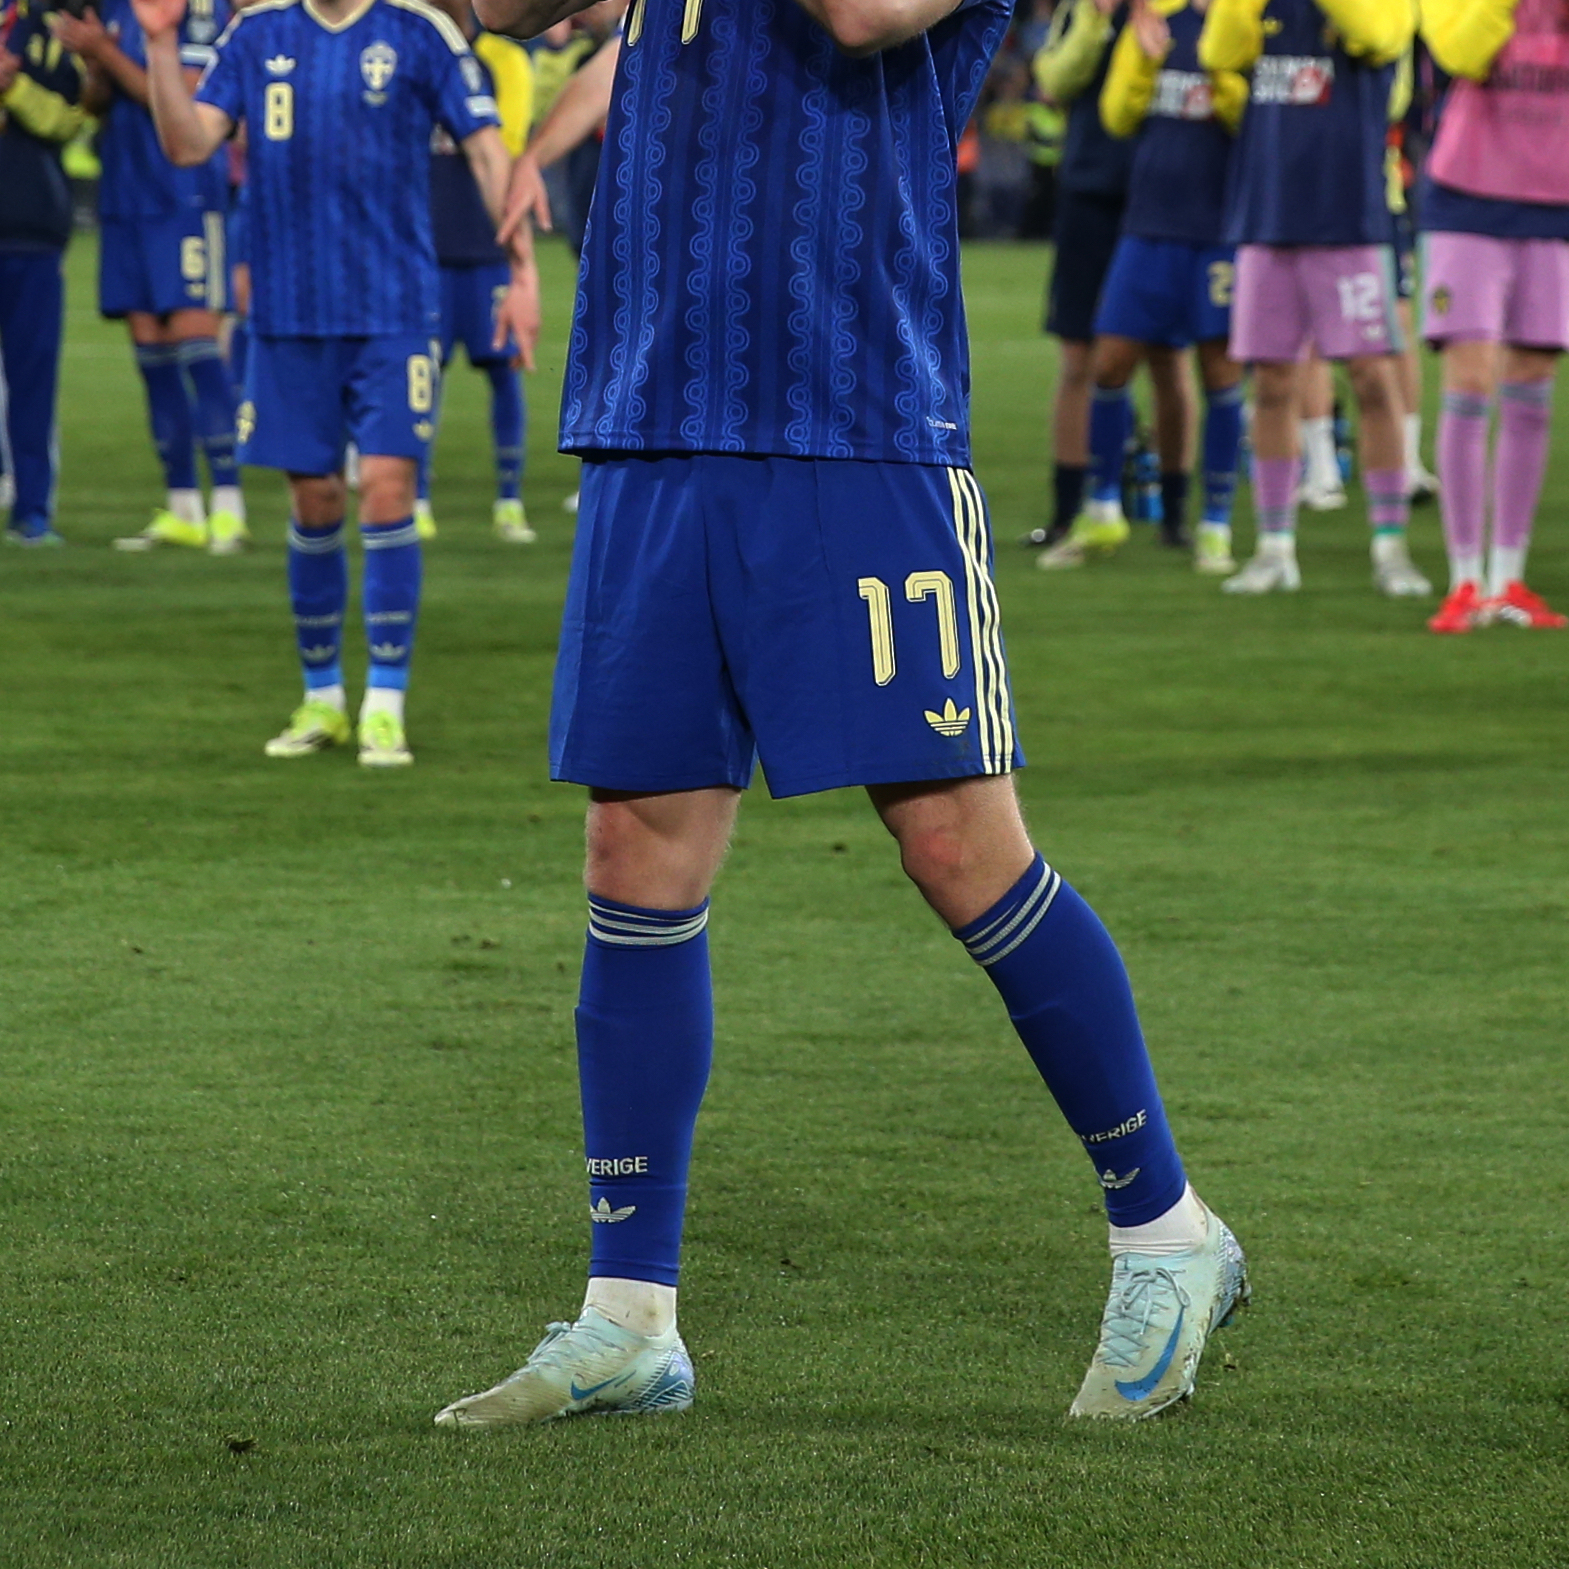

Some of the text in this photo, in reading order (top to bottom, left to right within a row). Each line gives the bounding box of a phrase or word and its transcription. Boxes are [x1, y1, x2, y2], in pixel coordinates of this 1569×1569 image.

[264, 81, 295, 142] 8
[406, 353, 433, 414] 8
[857, 570, 961, 687] 17
